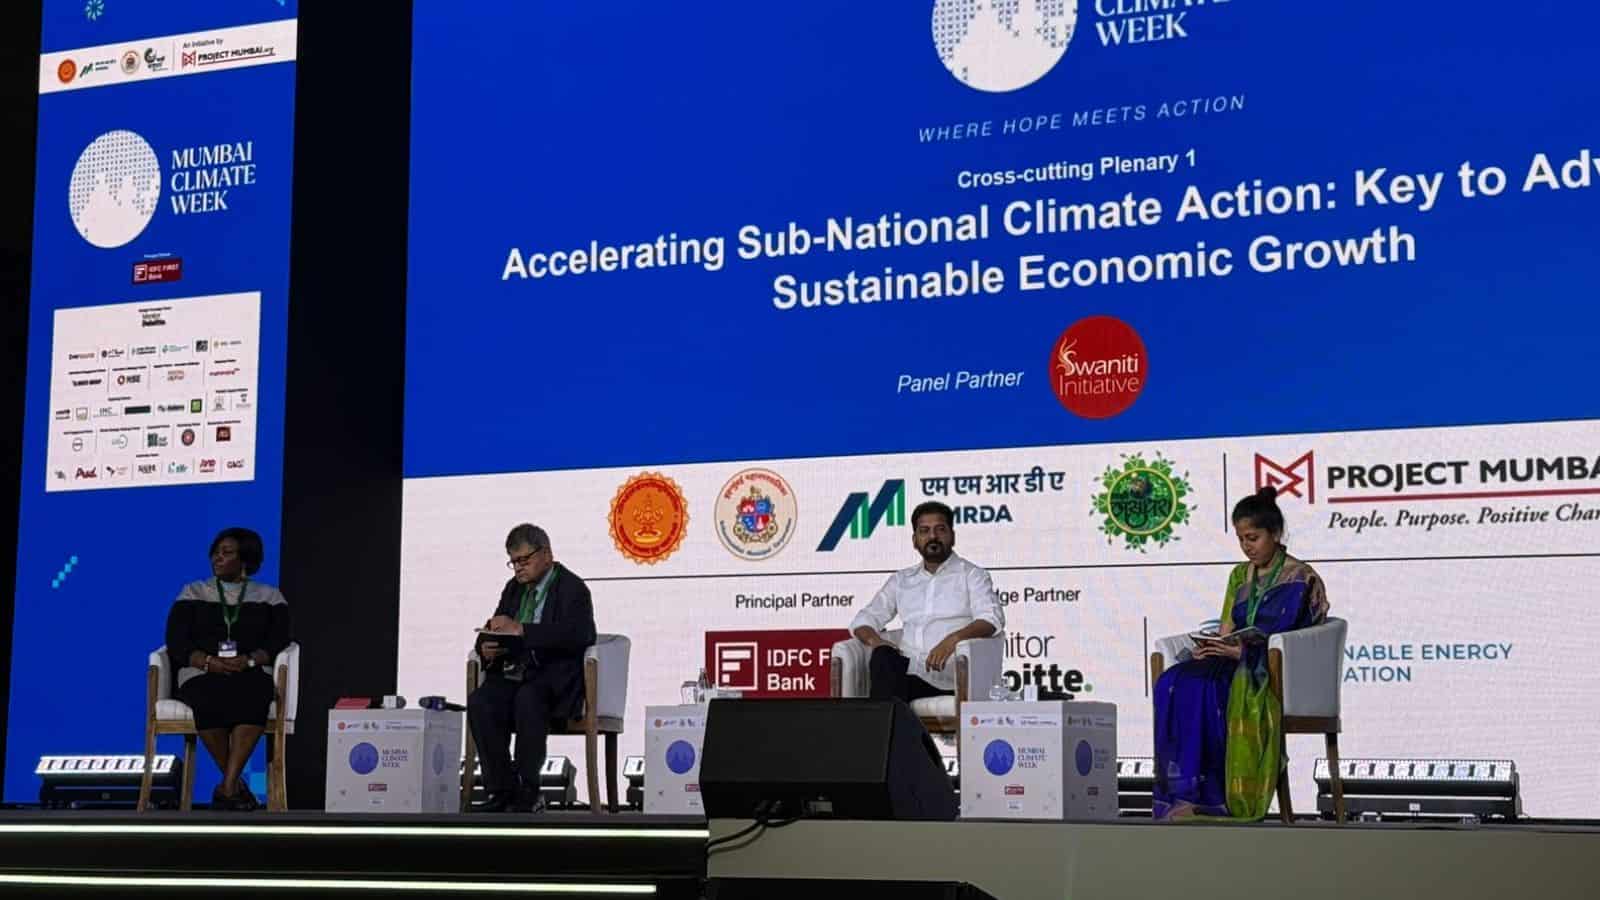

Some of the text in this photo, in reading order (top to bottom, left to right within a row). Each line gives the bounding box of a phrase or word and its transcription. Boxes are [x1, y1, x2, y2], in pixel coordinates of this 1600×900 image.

[1095, 11, 1188, 47] WEEK
[198, 51, 229, 62] PROJECT
[919, 95, 1245, 143] WHERE HOPE MEETS ACTION
[171, 141, 254, 170] MUMBAI
[957, 149, 1195, 189] Cross-cutting Plenary 1
[171, 163, 256, 192] CLIMATE
[171, 190, 228, 215] WEEK
[502, 233, 726, 282] Accelerating
[737, 204, 992, 260] Sub-National
[1003, 192, 1163, 237] Climate
[1176, 180, 1338, 222] Action:
[1355, 167, 1443, 212] Key
[1458, 160, 1507, 198] to
[772, 225, 1417, 311] Sustainable Economic Growth
[1060, 350, 1139, 377] Swaniti
[897, 369, 1024, 394] Panel Partner
[1059, 374, 1140, 397] Initiative
[920, 466, 1066, 496] एम एम आर डी ए
[1327, 461, 1469, 493] PROJECT
[1327, 509, 1388, 535] People.
[1395, 507, 1470, 533] Purpose.
[1477, 504, 1550, 525] Positive
[736, 592, 855, 614] Principal Partner
[1023, 587, 1081, 604] Partner
[767, 648, 813, 667] IDFC
[1421, 643, 1513, 661] ENERGY
[767, 672, 816, 691] Bank
